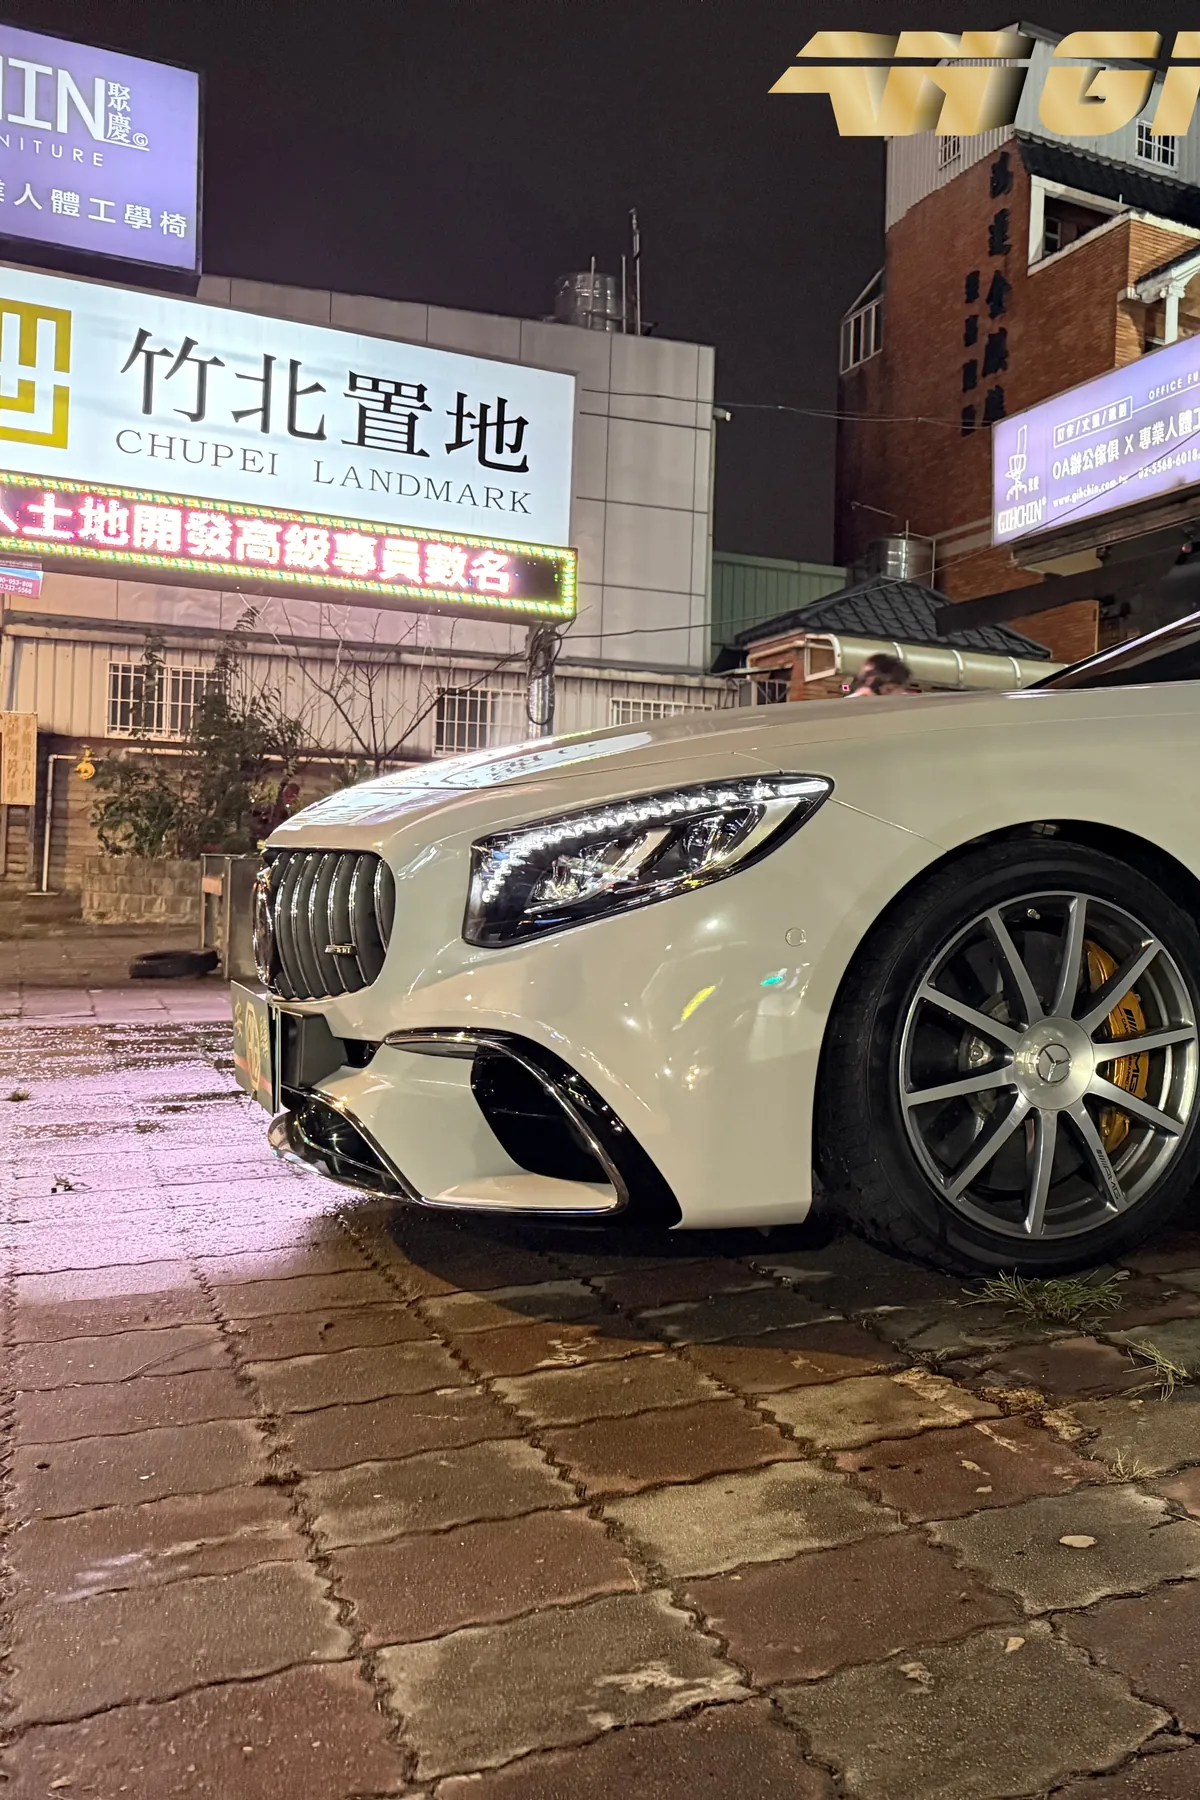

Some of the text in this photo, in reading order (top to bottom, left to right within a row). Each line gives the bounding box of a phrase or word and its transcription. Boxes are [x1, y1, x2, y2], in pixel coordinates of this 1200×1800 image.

[0, 55, 106, 140] IN
[107, 81, 131, 144] 聚慶
[0, 179, 187, 238] 人體工學椅
[120, 327, 530, 474] 竹北置地
[1148, 378, 1183, 400] OFFICE
[116, 429, 531, 515] CHUPEI LANDMARK
